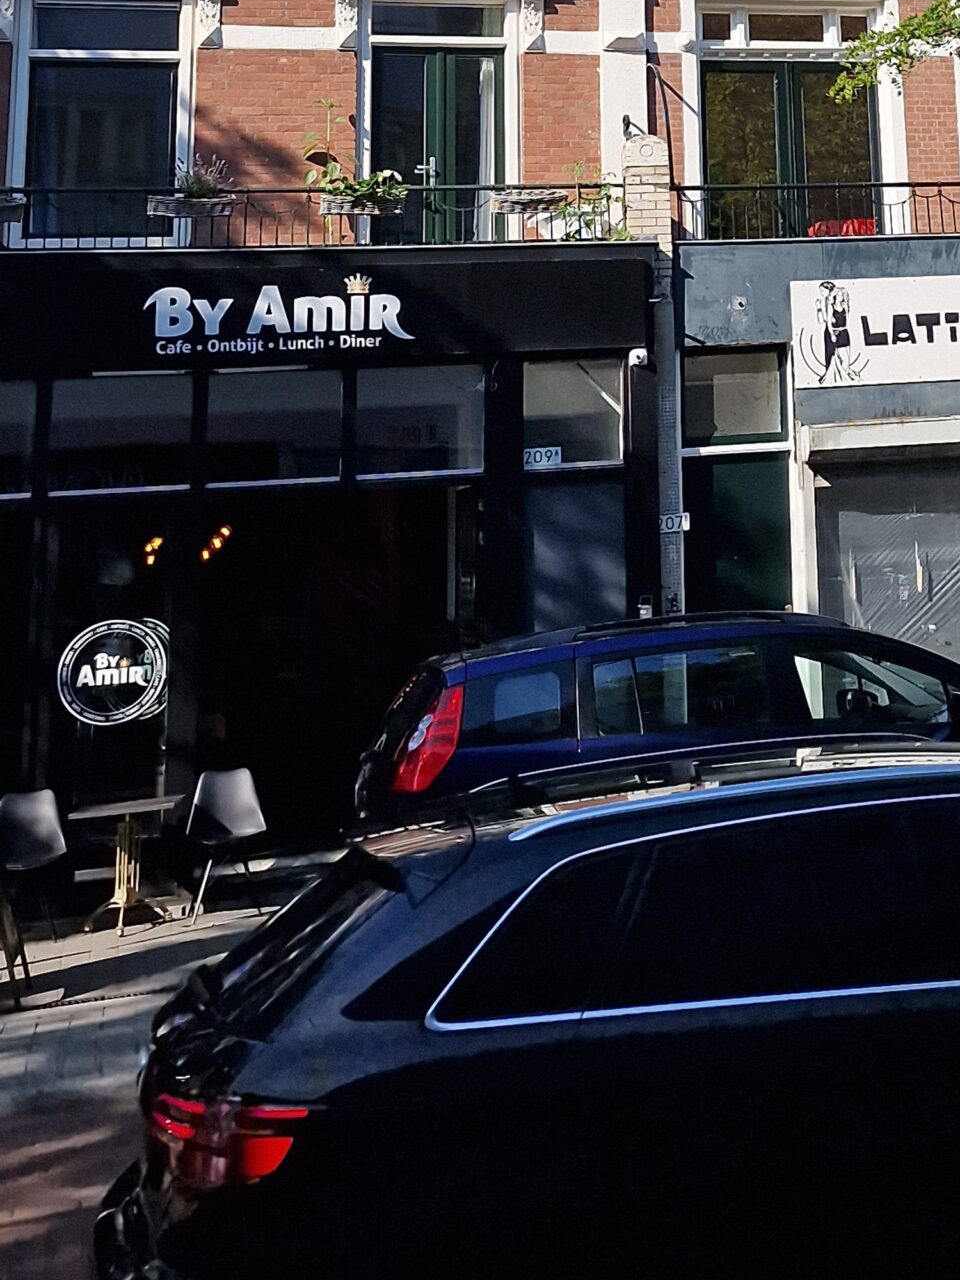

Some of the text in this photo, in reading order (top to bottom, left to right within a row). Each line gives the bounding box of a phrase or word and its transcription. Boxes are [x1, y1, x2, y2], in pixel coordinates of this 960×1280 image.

[156, 334, 382, 355] Cafe Ontbijt Lunch Diner
